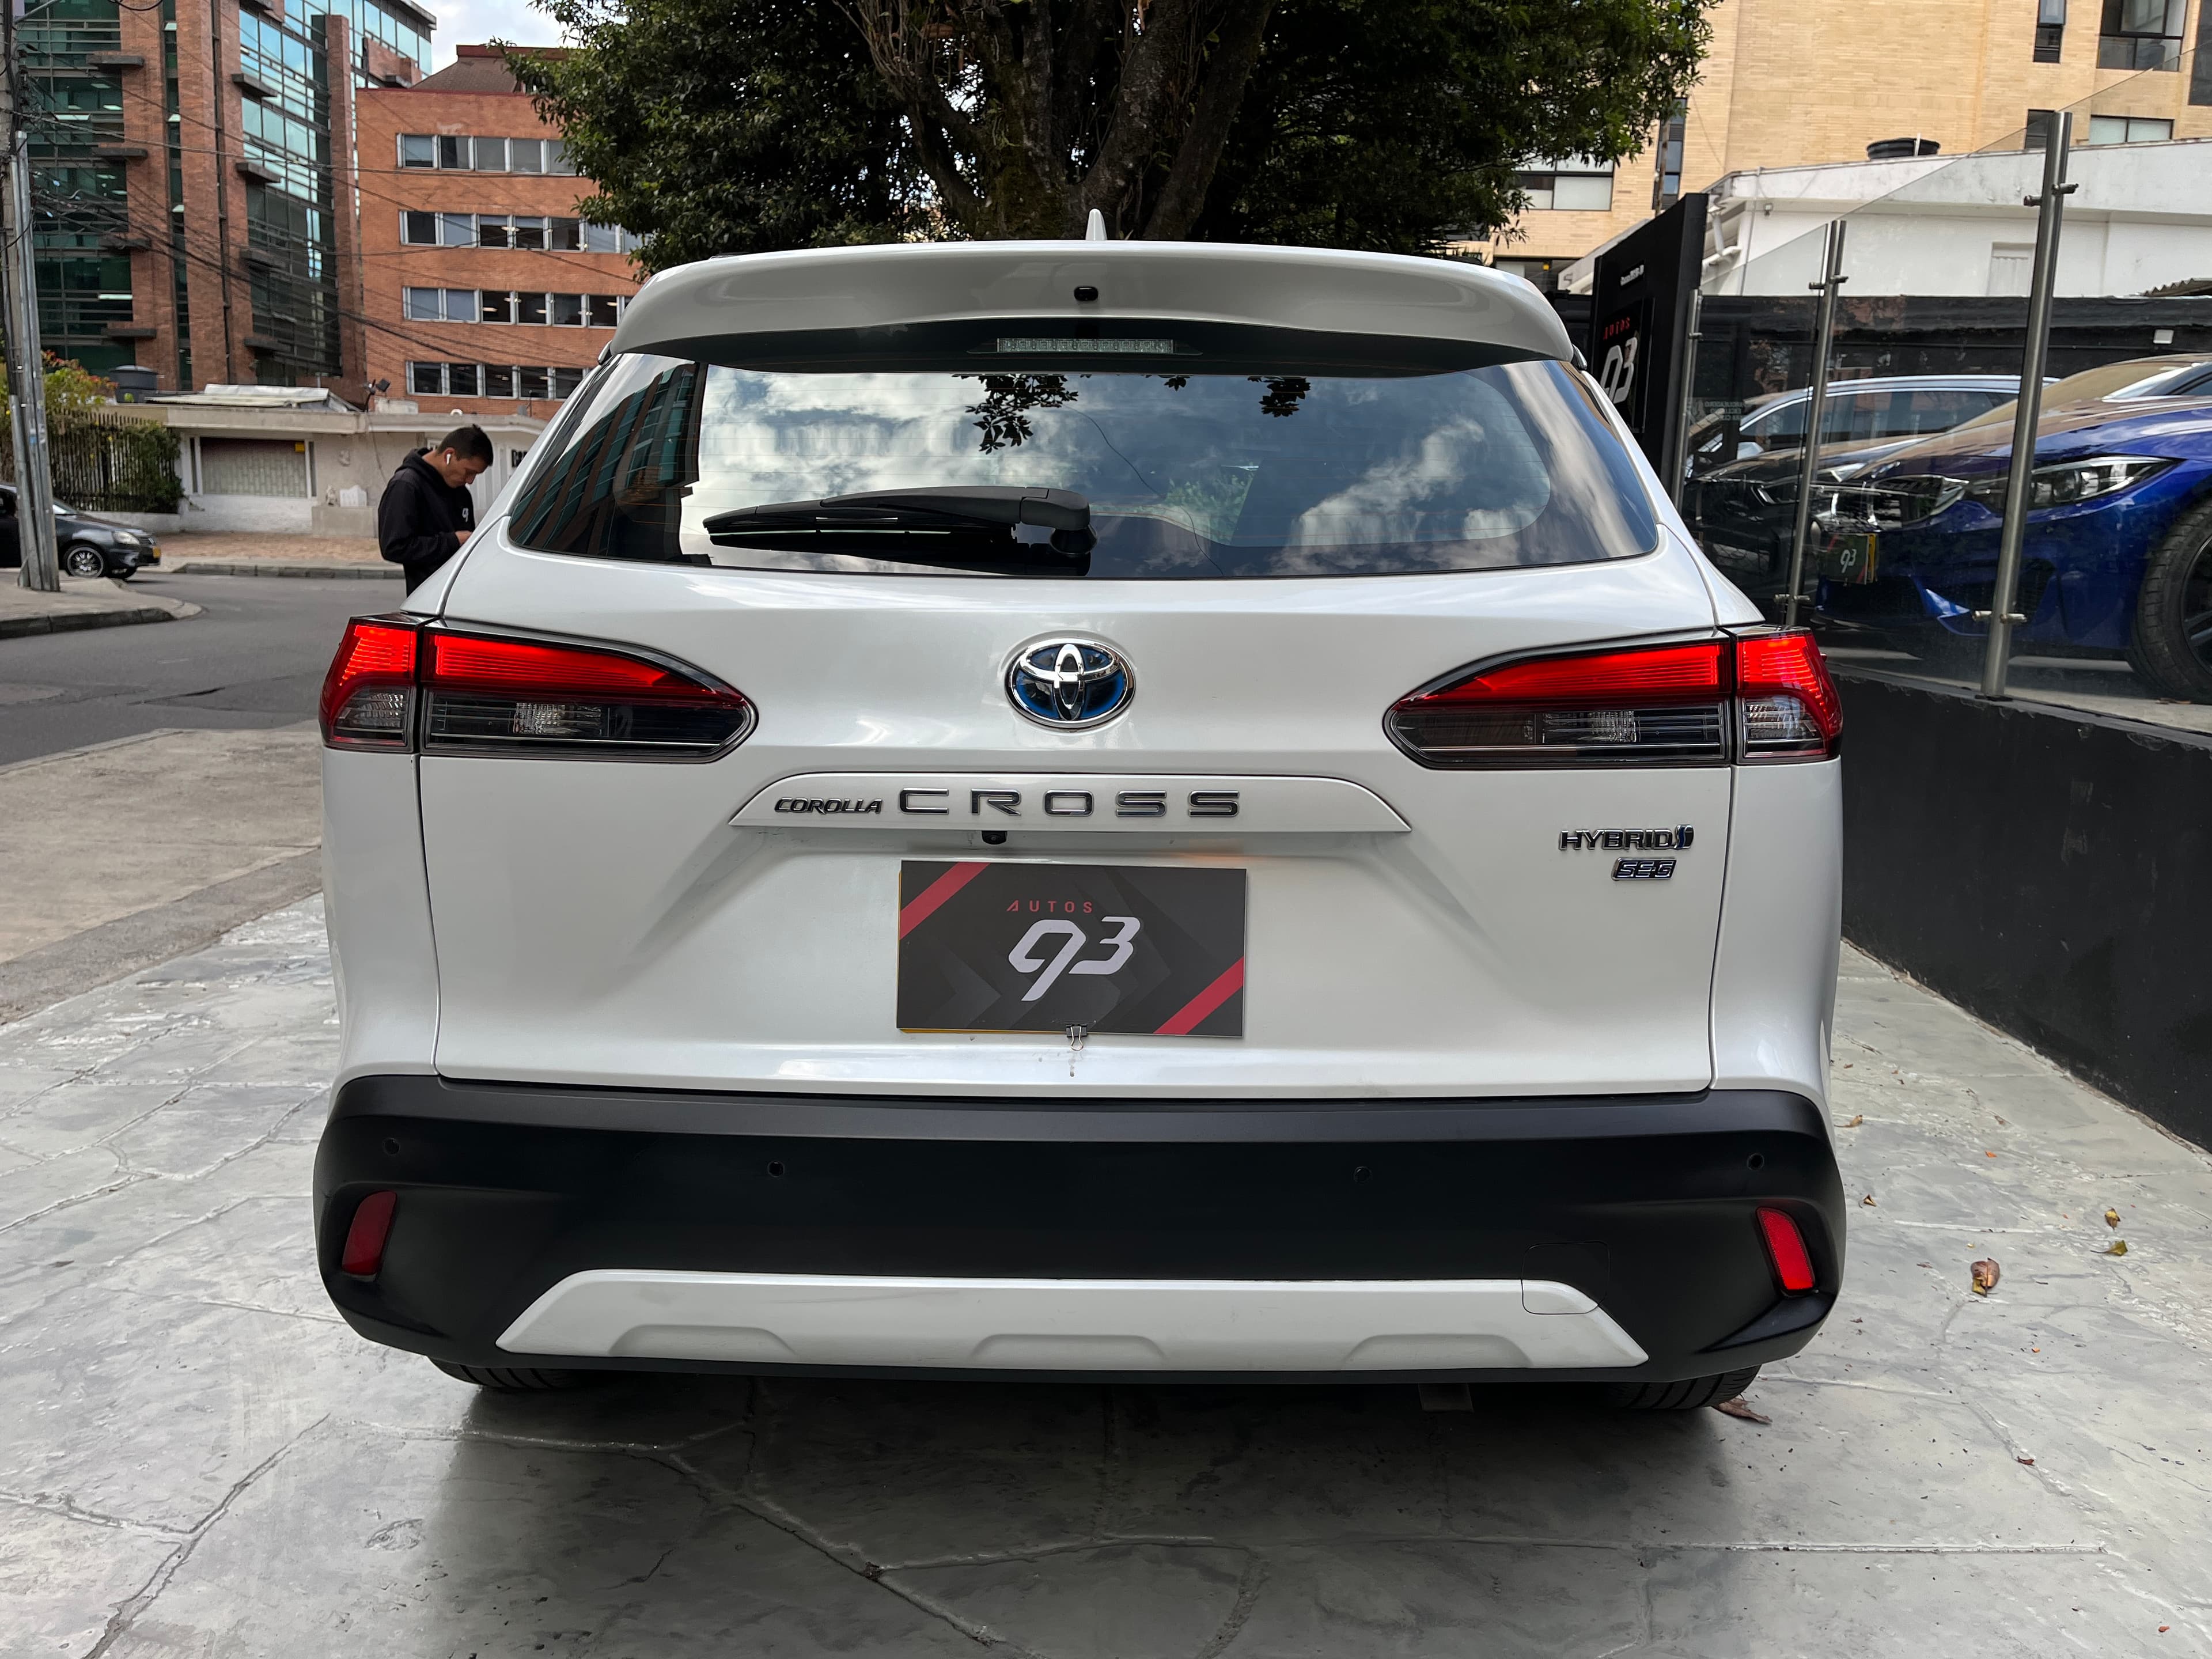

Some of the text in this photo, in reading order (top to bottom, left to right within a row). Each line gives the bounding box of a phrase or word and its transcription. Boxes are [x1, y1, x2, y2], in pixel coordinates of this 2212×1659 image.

[1603, 317, 1630, 340] AUTOS
[1600, 337, 1638, 403] 93
[1840, 548, 1857, 574] 93
[774, 787, 1240, 817] COROLLA CROSS
[1558, 828, 1673, 850] HYBRID
[1006, 900, 1093, 914] AUTOS
[1008, 916, 1141, 1001] 93
